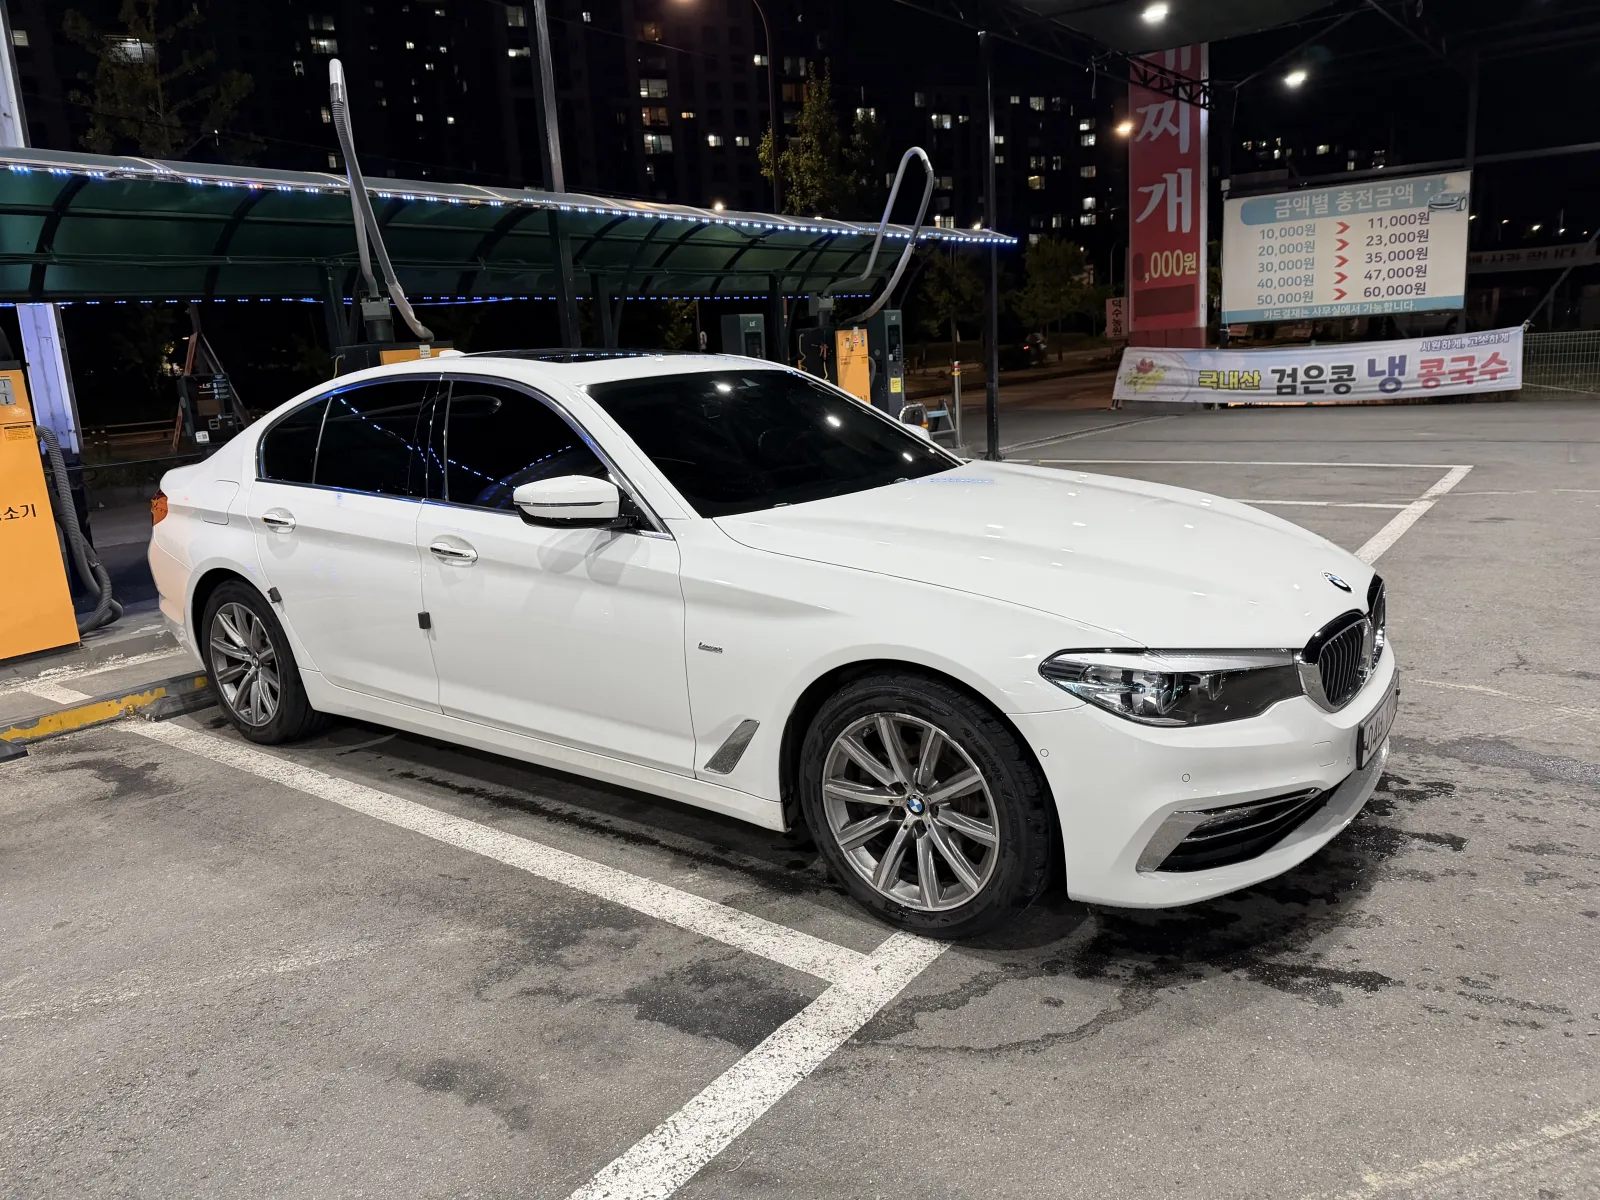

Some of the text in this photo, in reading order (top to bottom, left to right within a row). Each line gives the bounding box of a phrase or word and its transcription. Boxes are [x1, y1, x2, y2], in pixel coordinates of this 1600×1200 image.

[1274, 183, 1414, 219] 금액별 충전금액
[1259, 211, 1431, 241] 10,000원 11,000원
[1258, 229, 1430, 257] 20,000원 23,000원
[1258, 247, 1429, 274] 30,000원 35,000원
[1257, 264, 1428, 290] 40,000원 47,000원
[1257, 282, 1427, 307] 50,000원 60,000원
[1312, 305, 1361, 317] 사무실에서
[1420, 333, 1510, 352] 시원하게, 고소하게
[1198, 351, 1509, 396] 국내산 검은콩 냉 콩국수
[0, 503, 37, 521] 소기
